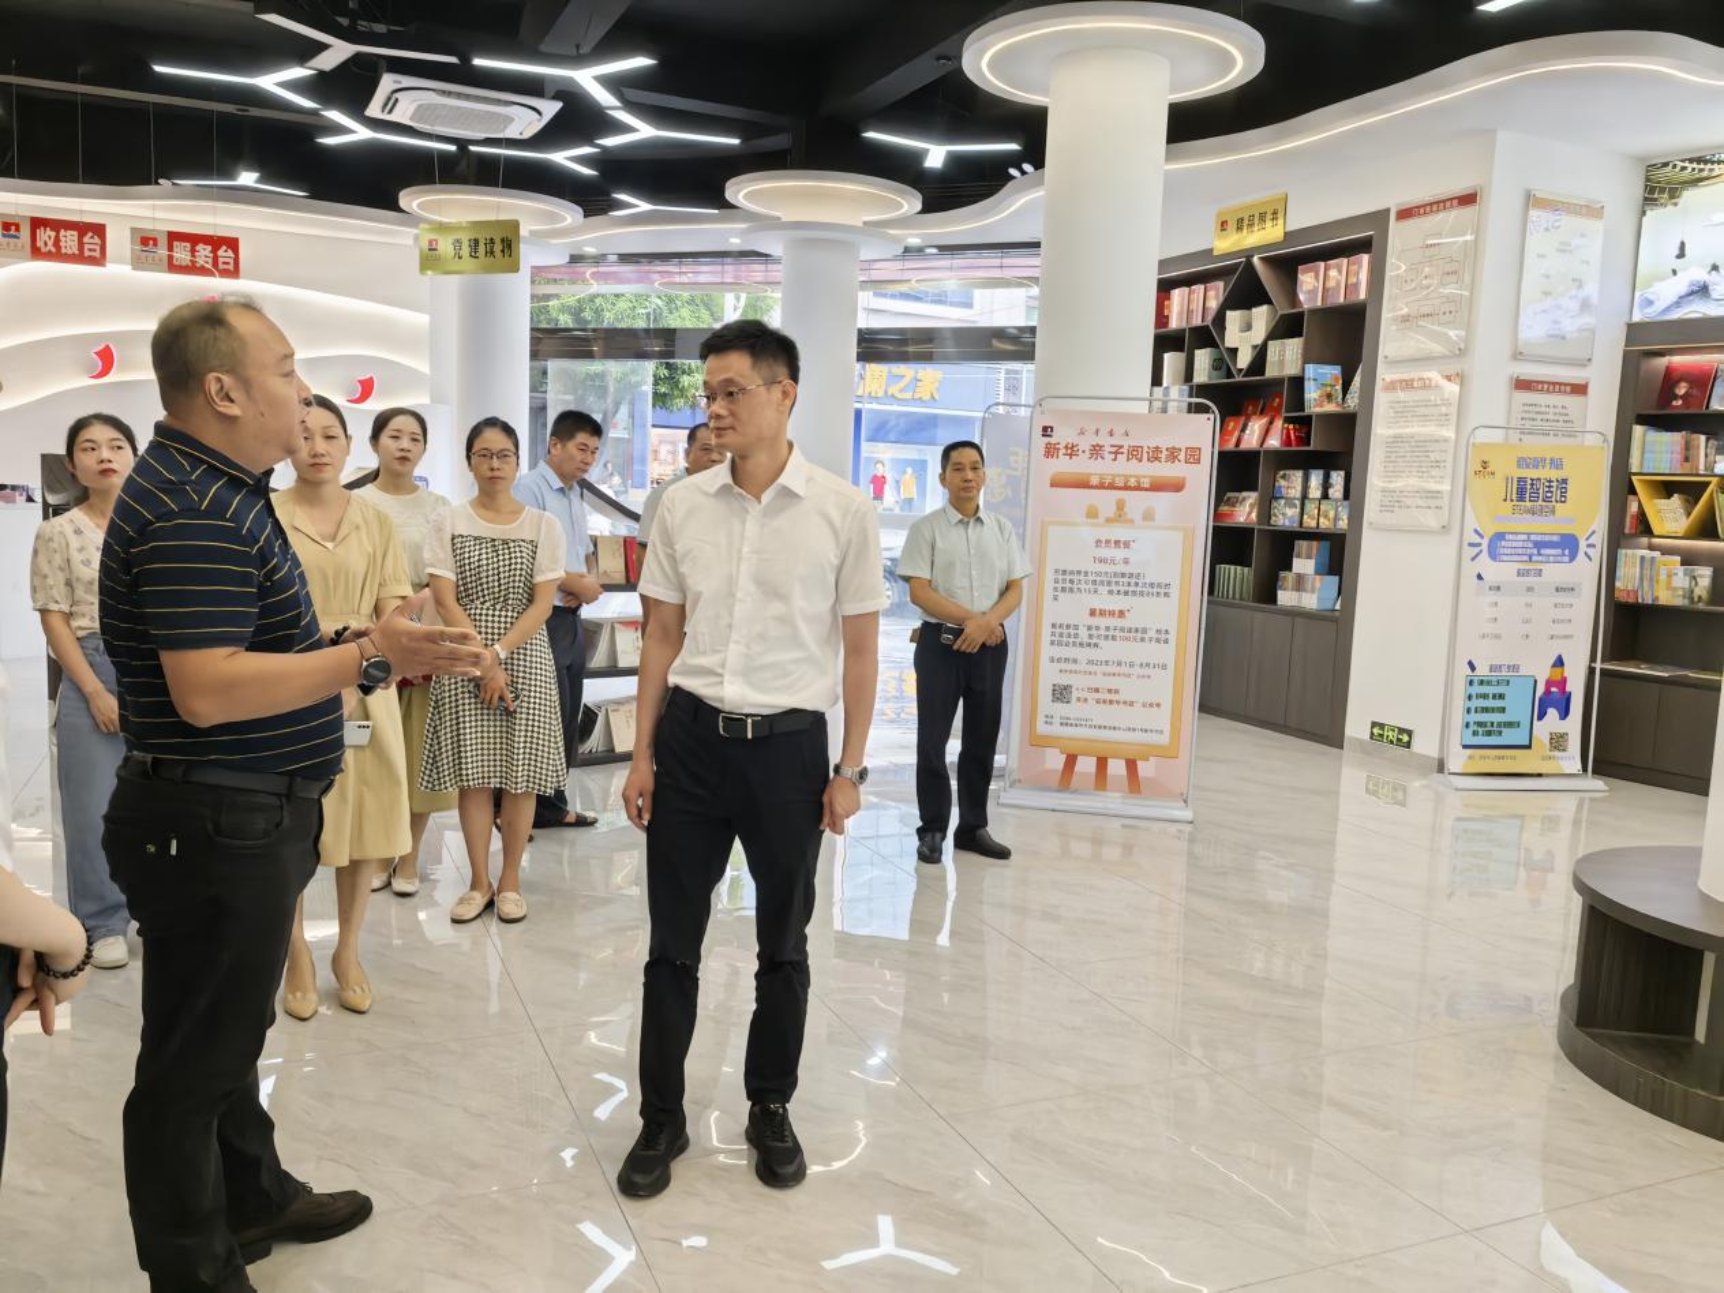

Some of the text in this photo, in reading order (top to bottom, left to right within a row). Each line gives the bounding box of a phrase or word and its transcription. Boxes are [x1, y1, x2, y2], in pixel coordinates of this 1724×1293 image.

[1235, 209, 1280, 234] 精品图书
[36, 226, 102, 258] 收银台
[452, 236, 512, 260] 党建读物
[172, 241, 235, 271] 服务台
[1043, 442, 1202, 465] 新华·亲子阅读家园
[1089, 475, 1151, 489] 亲子绘本馆
[1503, 476, 1568, 503] 儿童智造馆
